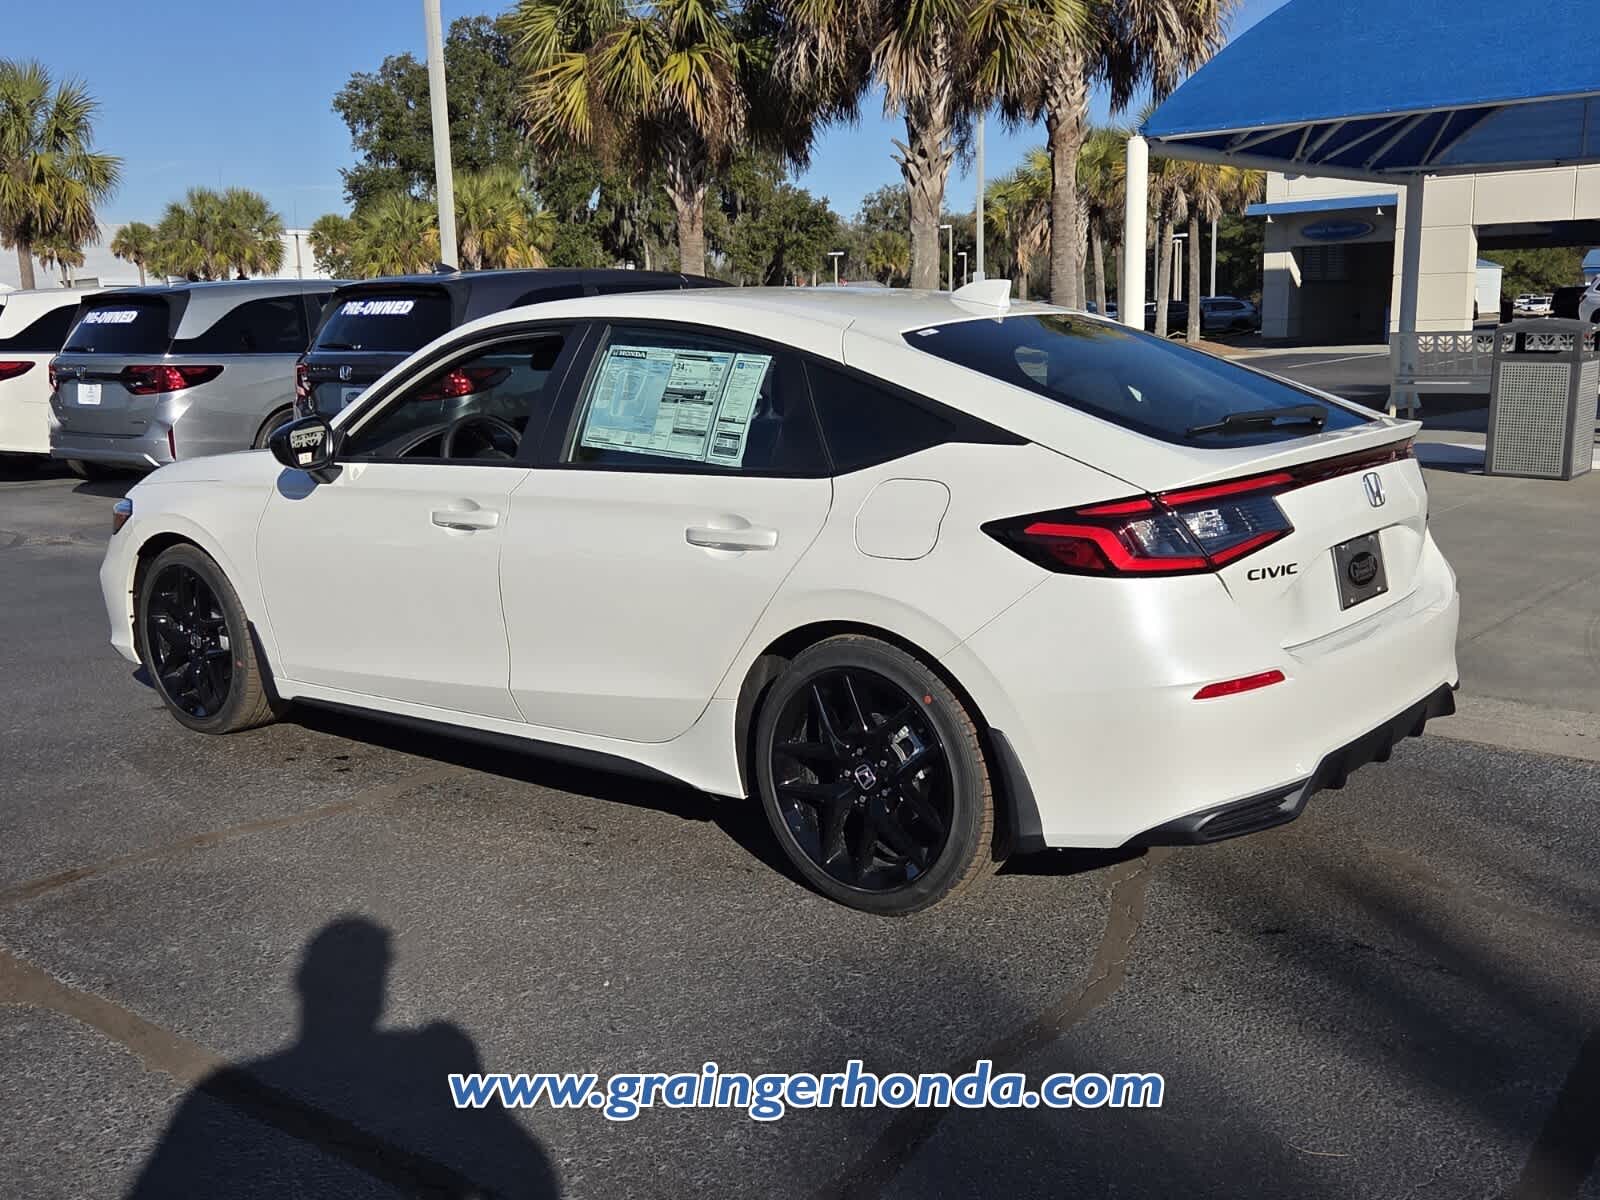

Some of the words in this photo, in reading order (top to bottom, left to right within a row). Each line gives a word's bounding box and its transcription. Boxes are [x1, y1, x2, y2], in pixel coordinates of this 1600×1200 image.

[340, 300, 416, 316] PRE-OWNED
[82, 310, 138, 324] PRE-OWNED
[619, 350, 646, 359] HONDA
[1247, 562, 1298, 581] CIVIC
